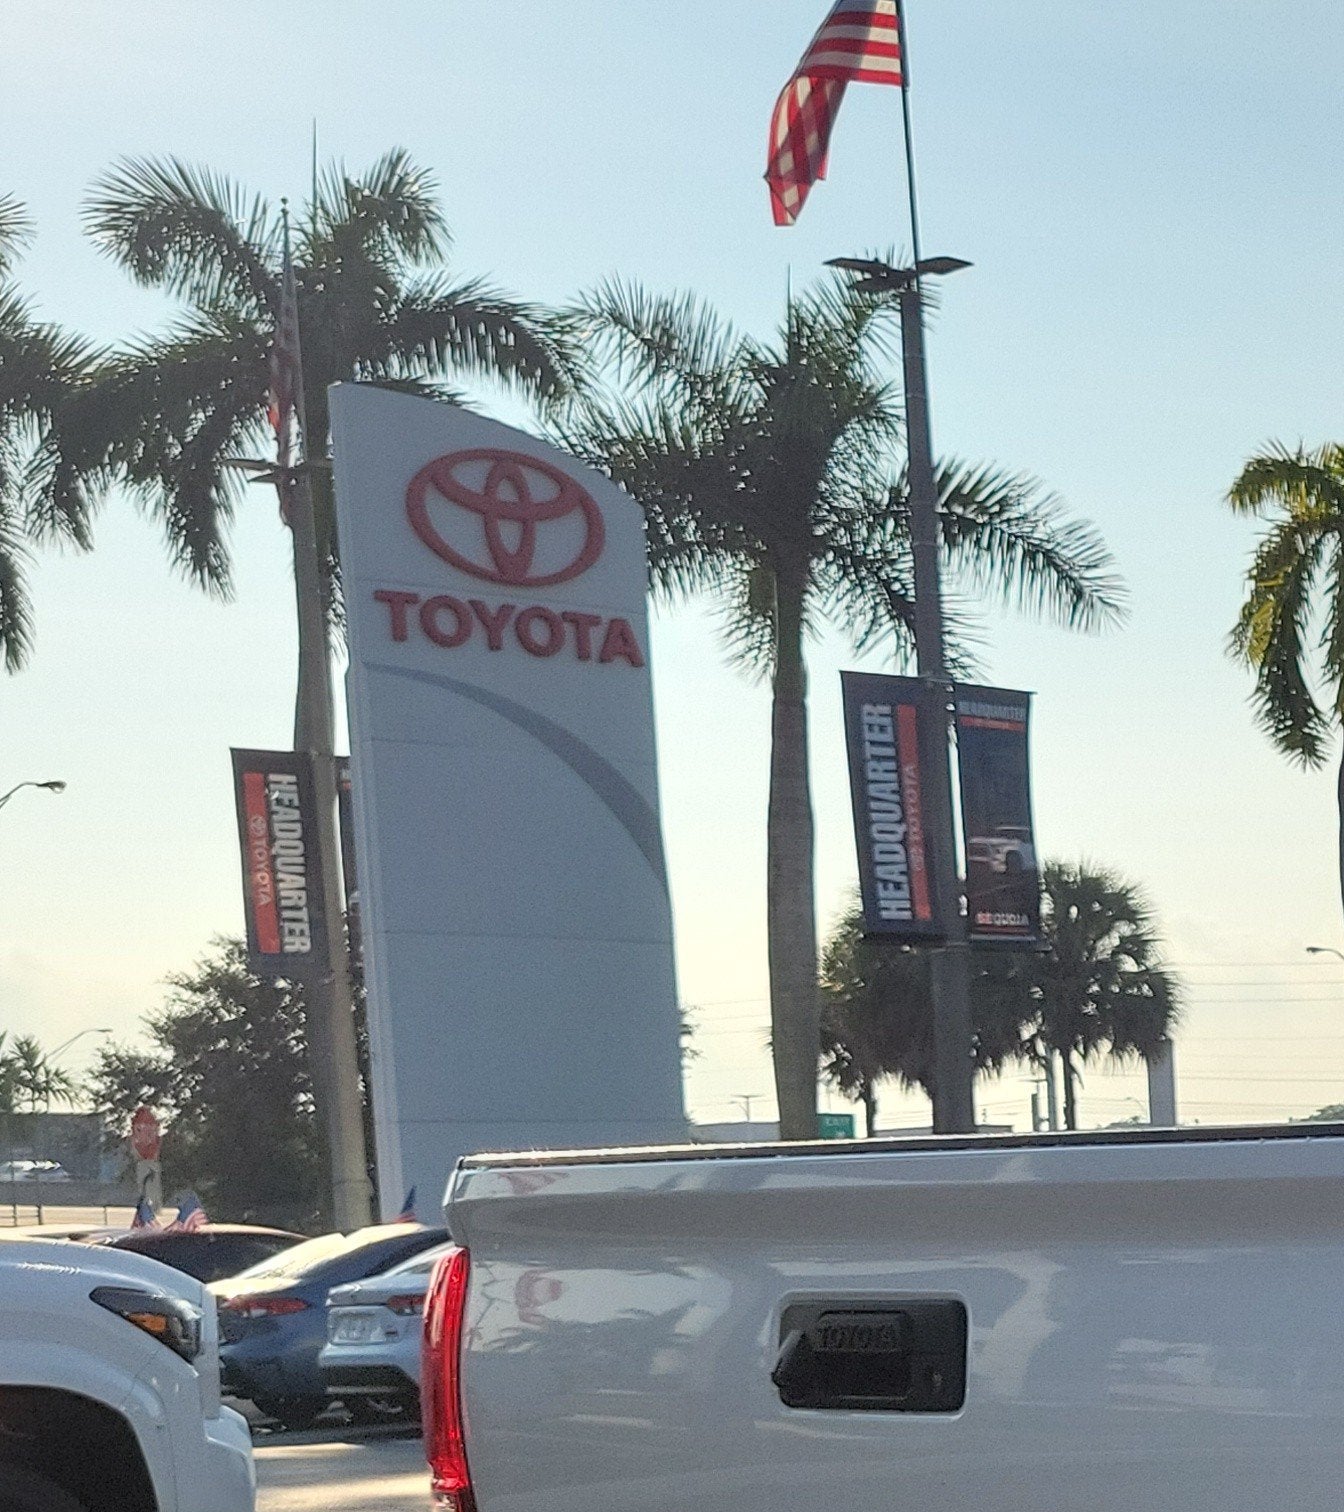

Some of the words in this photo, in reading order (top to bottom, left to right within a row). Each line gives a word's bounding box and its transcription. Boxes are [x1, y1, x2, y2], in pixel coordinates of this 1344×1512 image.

[373, 589, 645, 669] TOYOTA
[267, 773, 312, 954] HEADQUARTER
[861, 703, 914, 921] HEADQUARTER
